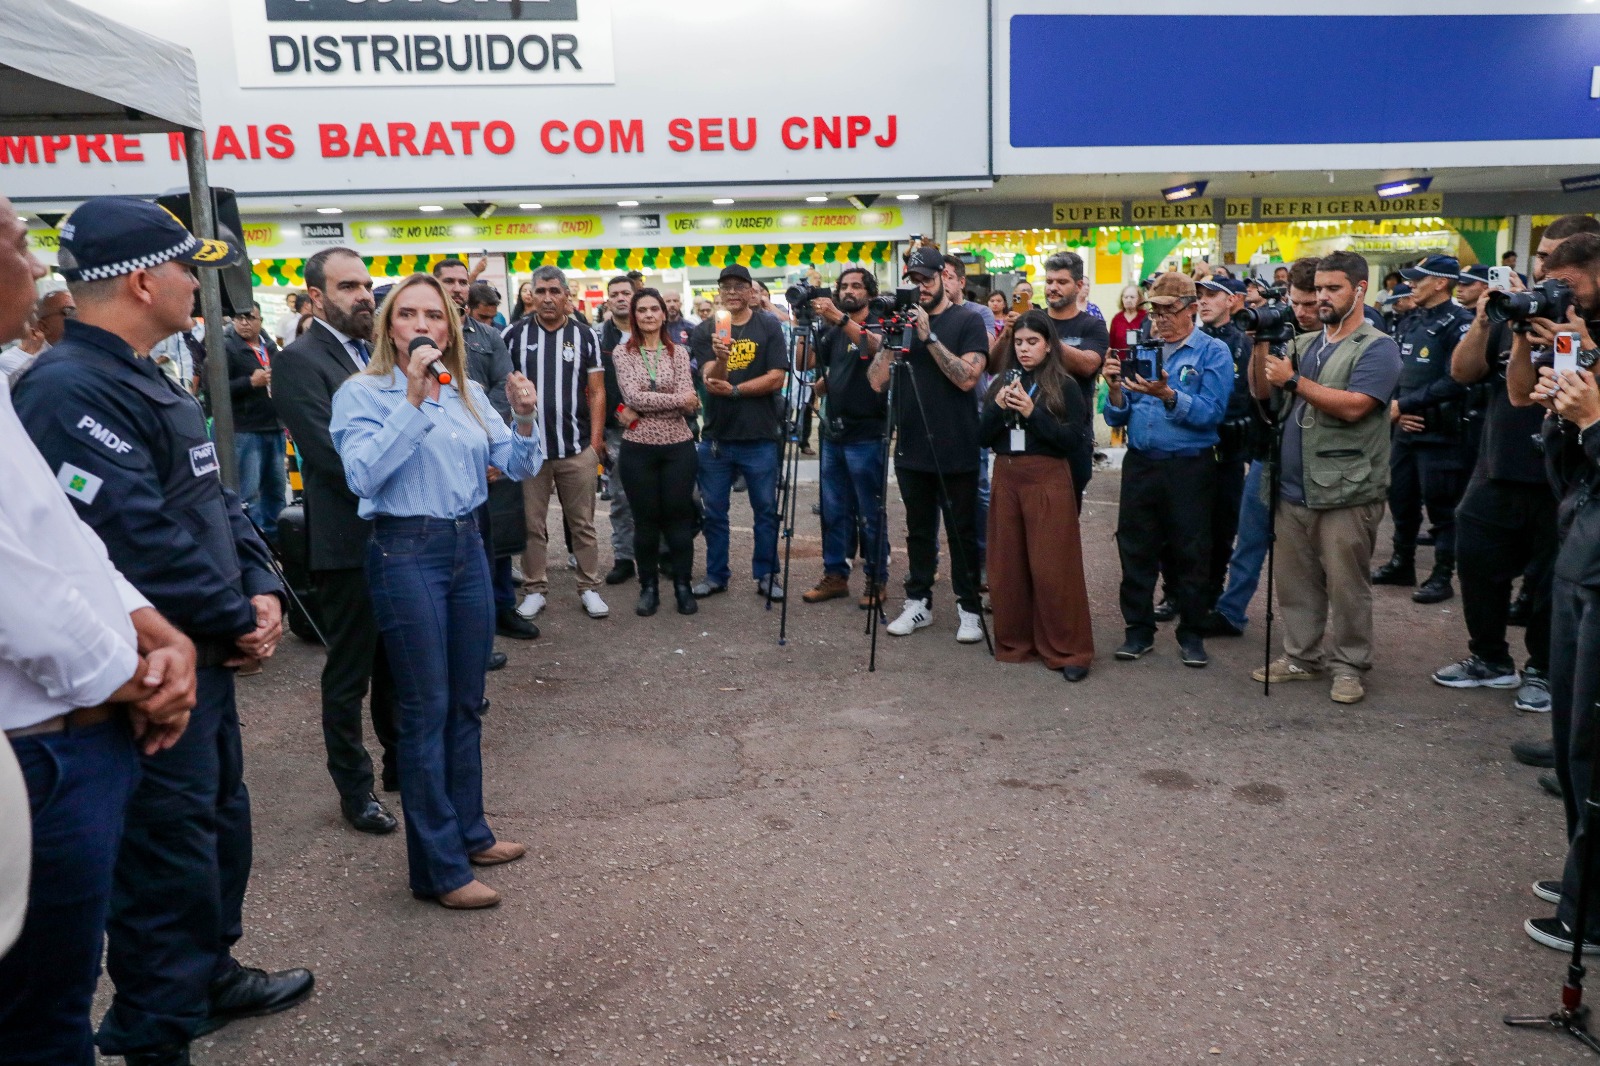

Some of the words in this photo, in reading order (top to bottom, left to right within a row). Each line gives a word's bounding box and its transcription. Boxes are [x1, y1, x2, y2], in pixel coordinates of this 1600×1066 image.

[269, 34, 582, 73] DISTRIBUIDOR
[319, 120, 516, 158] BARATO
[540, 119, 645, 154] COM
[668, 117, 758, 152] SEU
[782, 114, 898, 150] CNPJ
[1056, 207, 1122, 221] SUPER
[1133, 204, 1212, 219] OFERTA
[1227, 203, 1250, 216] DE
[1262, 199, 1441, 215] REFRIGERADORES
[407, 226, 422, 237] NO
[424, 225, 459, 237] VARE
[494, 223, 503, 235] E
[76, 414, 133, 454] PMDF
